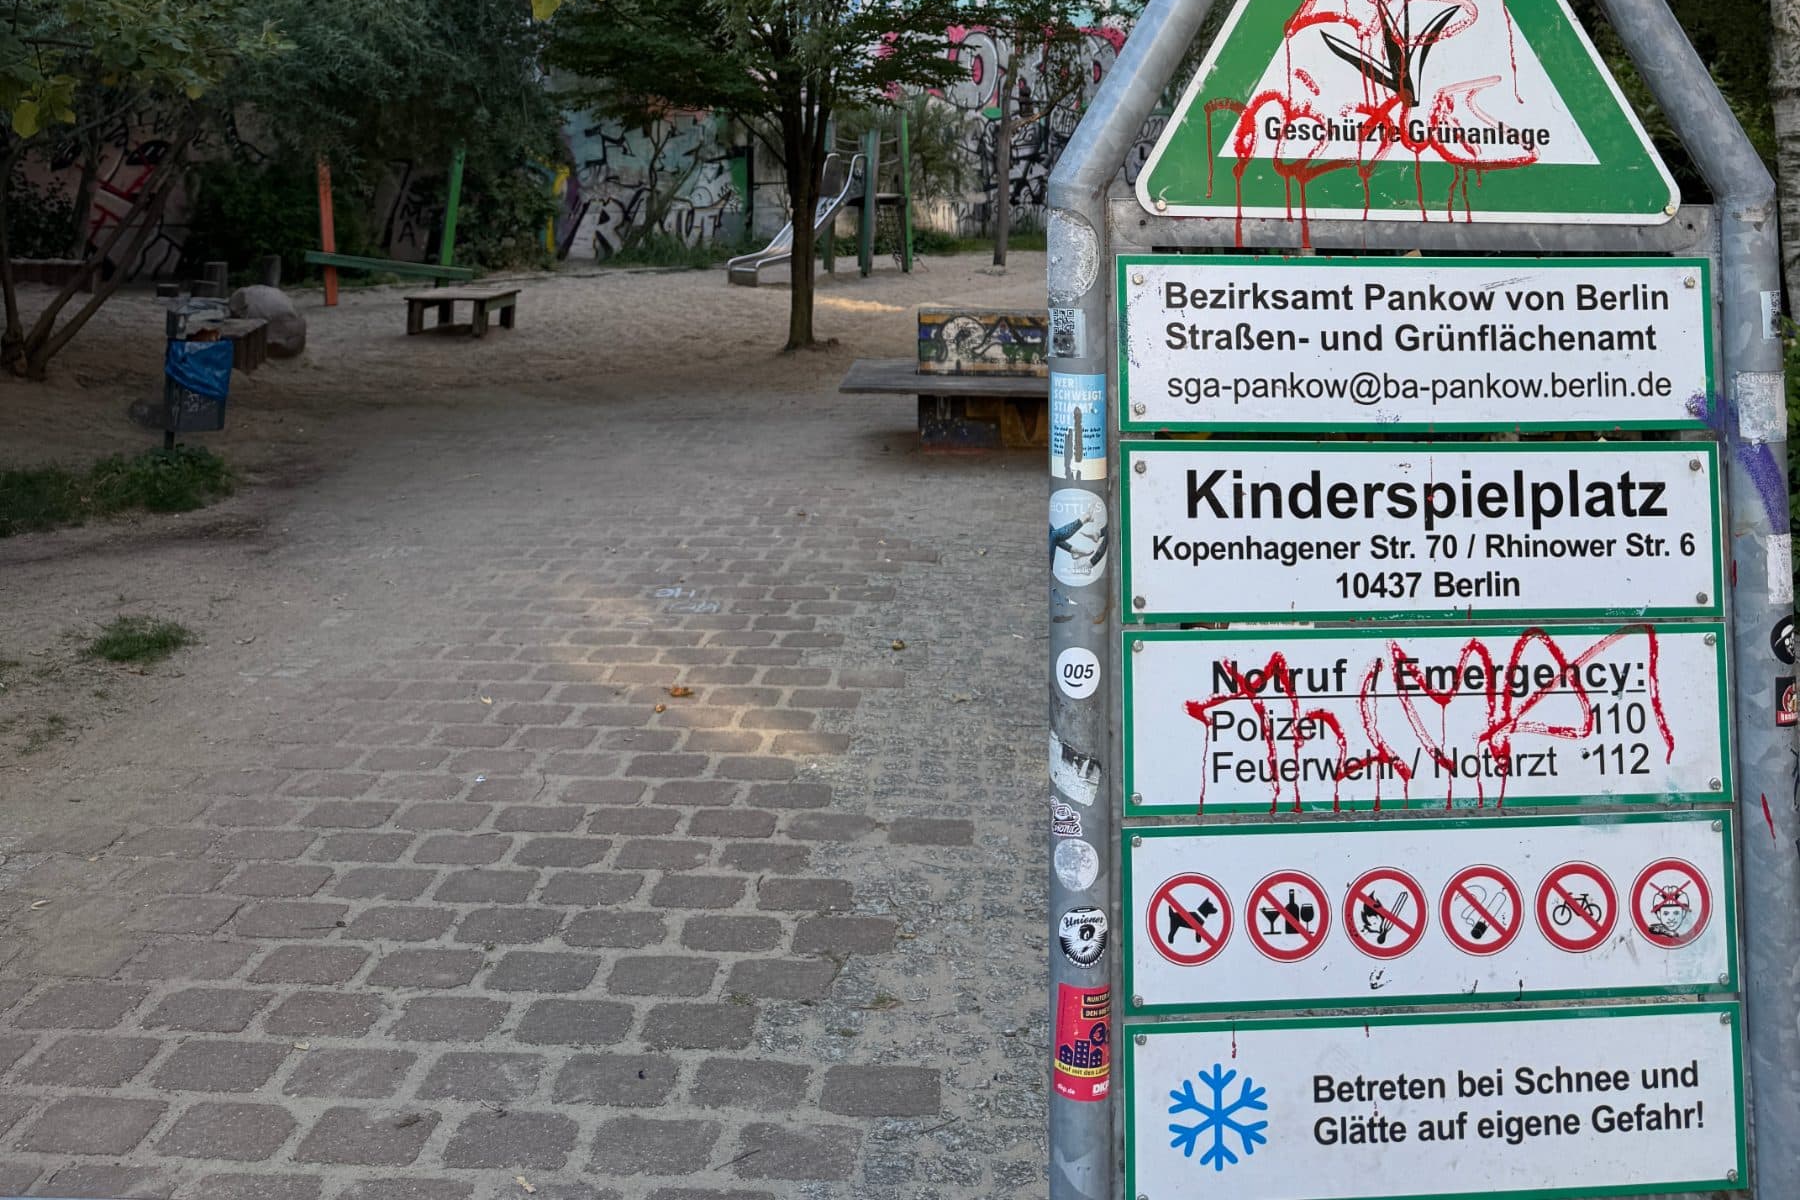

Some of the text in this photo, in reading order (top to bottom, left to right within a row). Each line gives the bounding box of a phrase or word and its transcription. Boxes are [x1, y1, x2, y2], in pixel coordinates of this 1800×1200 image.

[1264, 116, 1551, 149] Geschützte Grünanlage
[1165, 281, 1669, 311] Bezirksamt Pankow von Berlin
[1166, 322, 1657, 352] Straßen- und Grünflächenamt
[1054, 376, 1074, 388] WER
[1167, 371, 1672, 406] sga-pankow@ba-pankow.berlin.de
[1186, 469, 1668, 531] Kinderspielplatz
[1153, 532, 1696, 567] Kopenhagener Str. 70 / Rhinower Str. 6
[1336, 571, 1520, 599] 10437 Berlin
[1063, 663, 1095, 680] 005
[1211, 658, 1348, 694] Notruf
[1396, 657, 1646, 697] Emergency:
[1211, 701, 1647, 742] Polizei 110
[1410, 746, 1422, 780] /
[1433, 746, 1559, 779] Notarzt
[1592, 742, 1652, 776] 112
[1313, 1059, 1699, 1103] Betreten bei Schnee und
[1313, 1100, 1704, 1146] Glätte auf eigene Gefahr!
